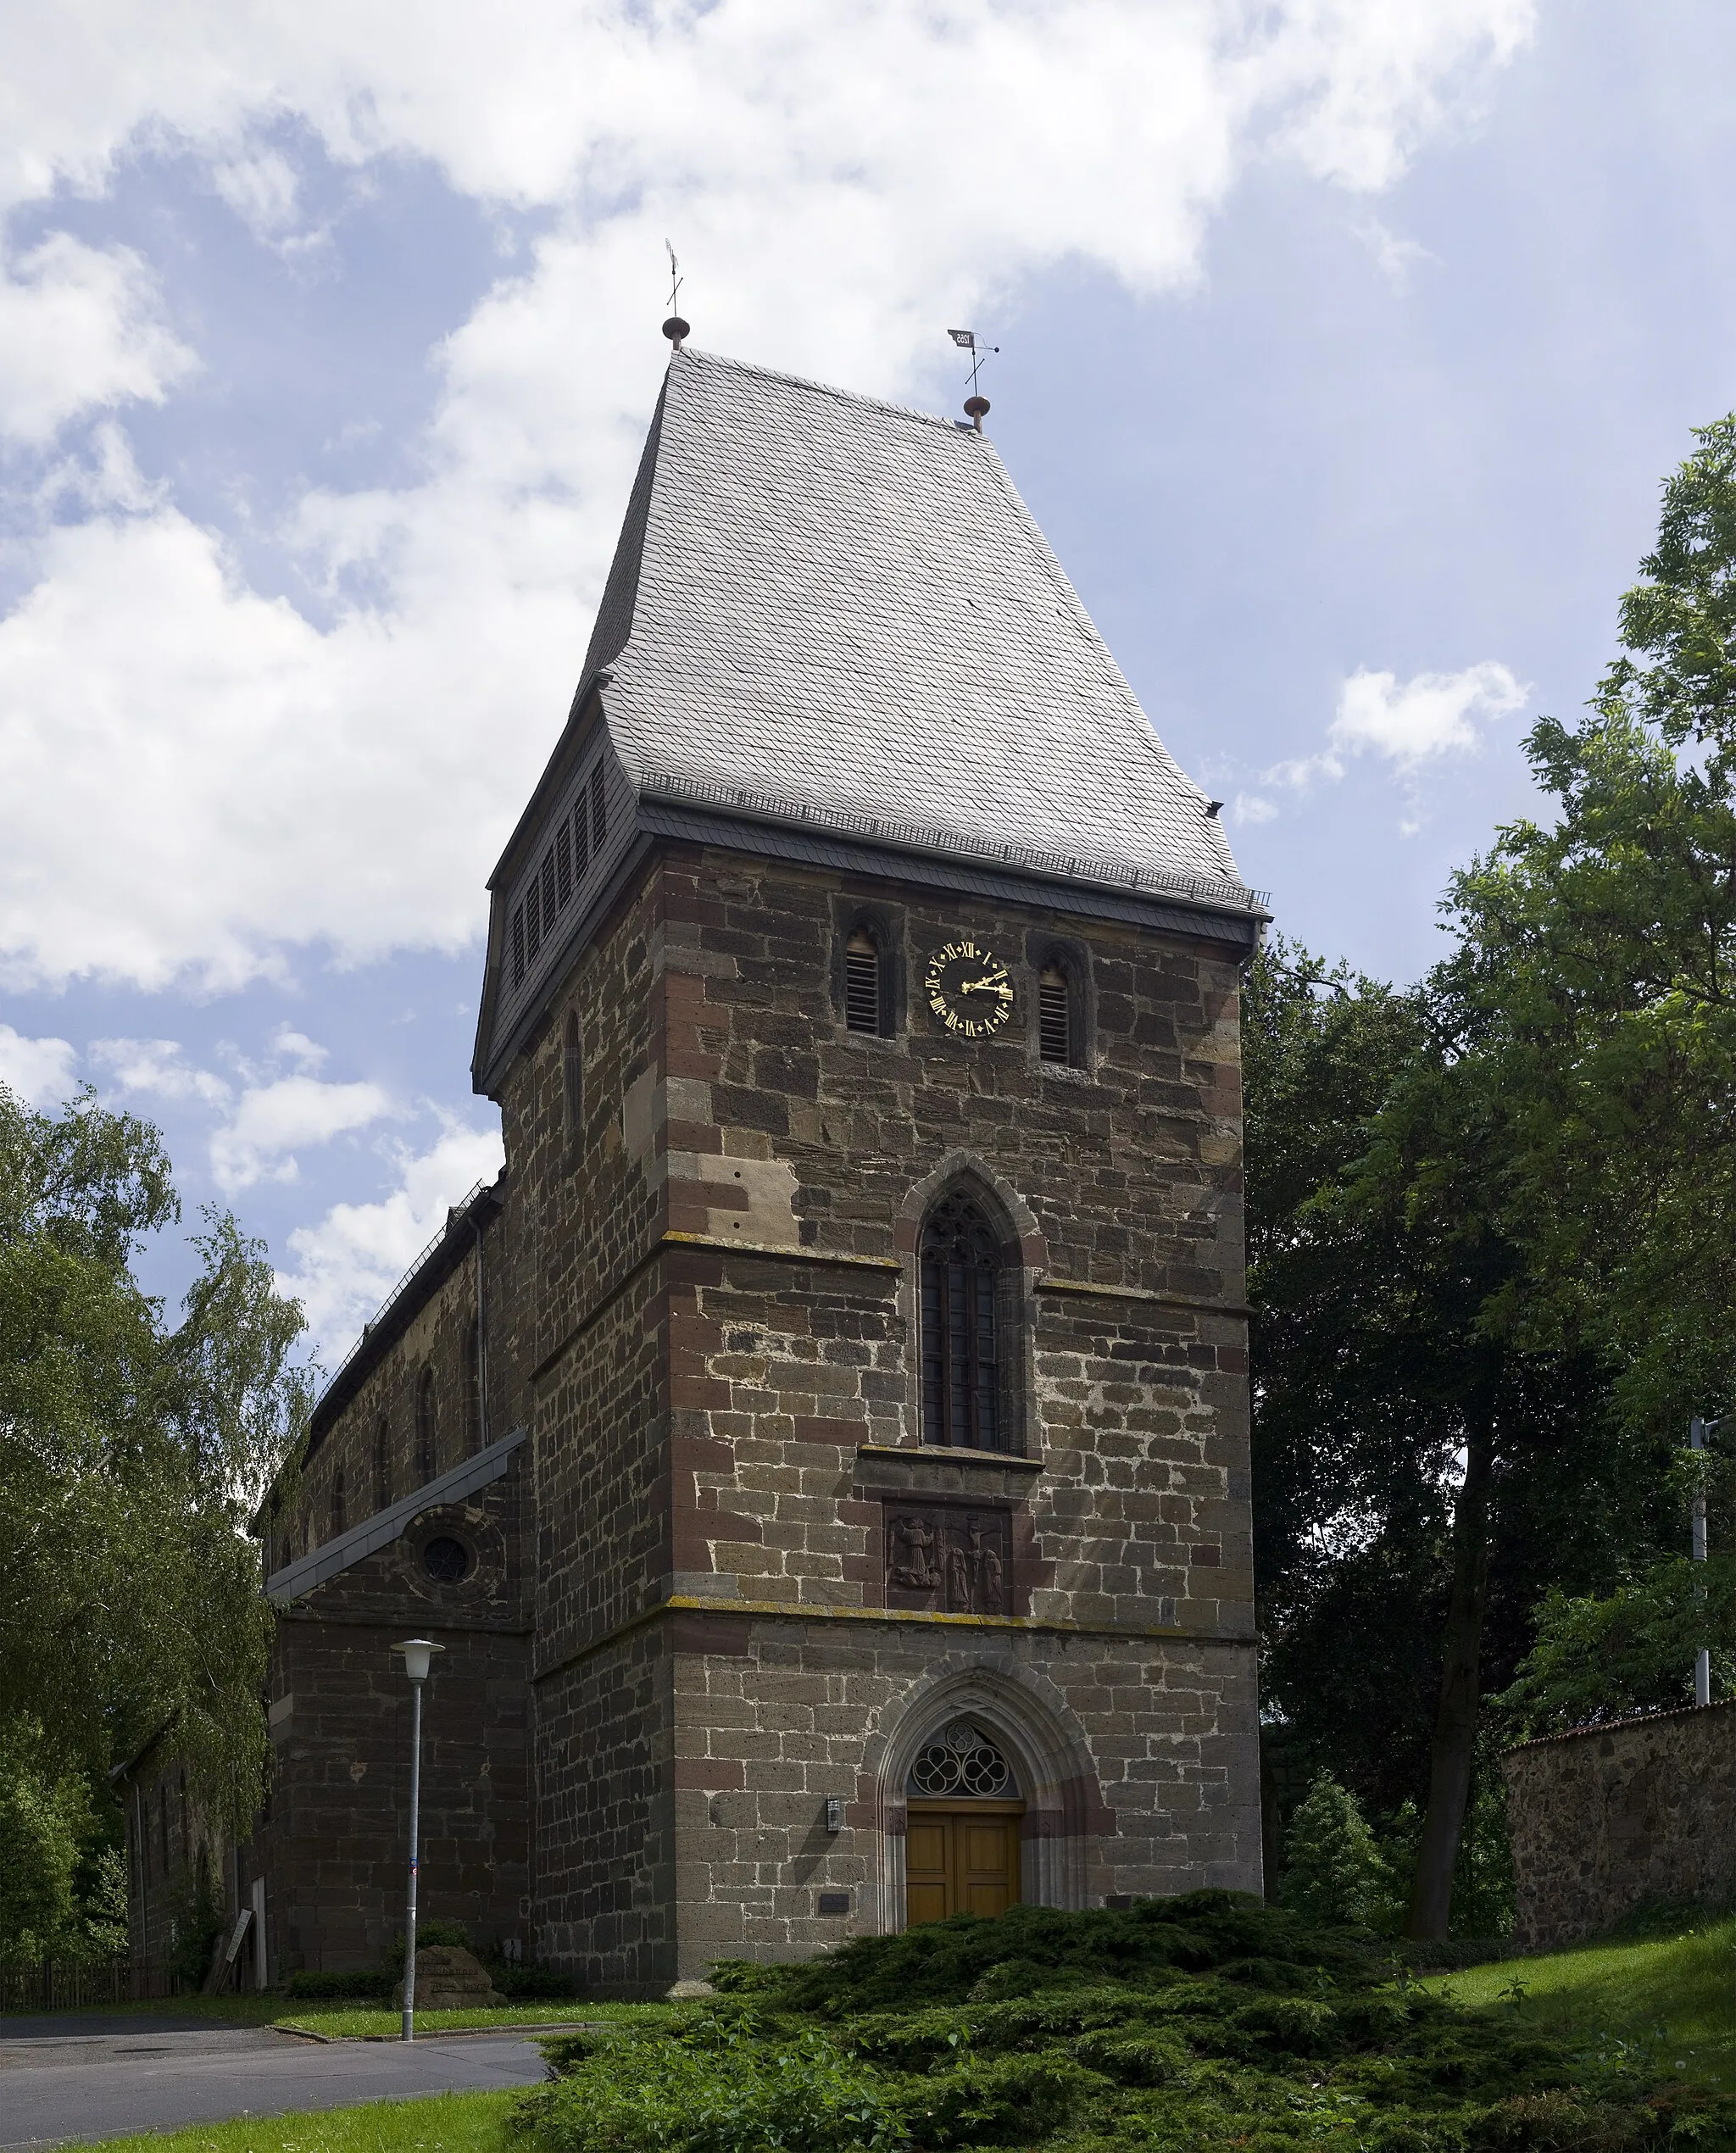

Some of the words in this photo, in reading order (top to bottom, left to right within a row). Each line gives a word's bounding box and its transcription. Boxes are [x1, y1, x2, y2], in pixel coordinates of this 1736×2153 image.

[943, 943, 958, 961] XI
[961, 942, 974, 959] XII
[982, 951, 992, 965] I
[929, 956, 945, 972] X
[926, 976, 940, 989] IX
[993, 970, 1008, 980] II
[930, 996, 946, 1015] VIII
[994, 1005, 1010, 1023] IV
[945, 1011, 958, 1030] VII
[965, 1020, 976, 1037] VI
[984, 1019, 996, 1035] V
